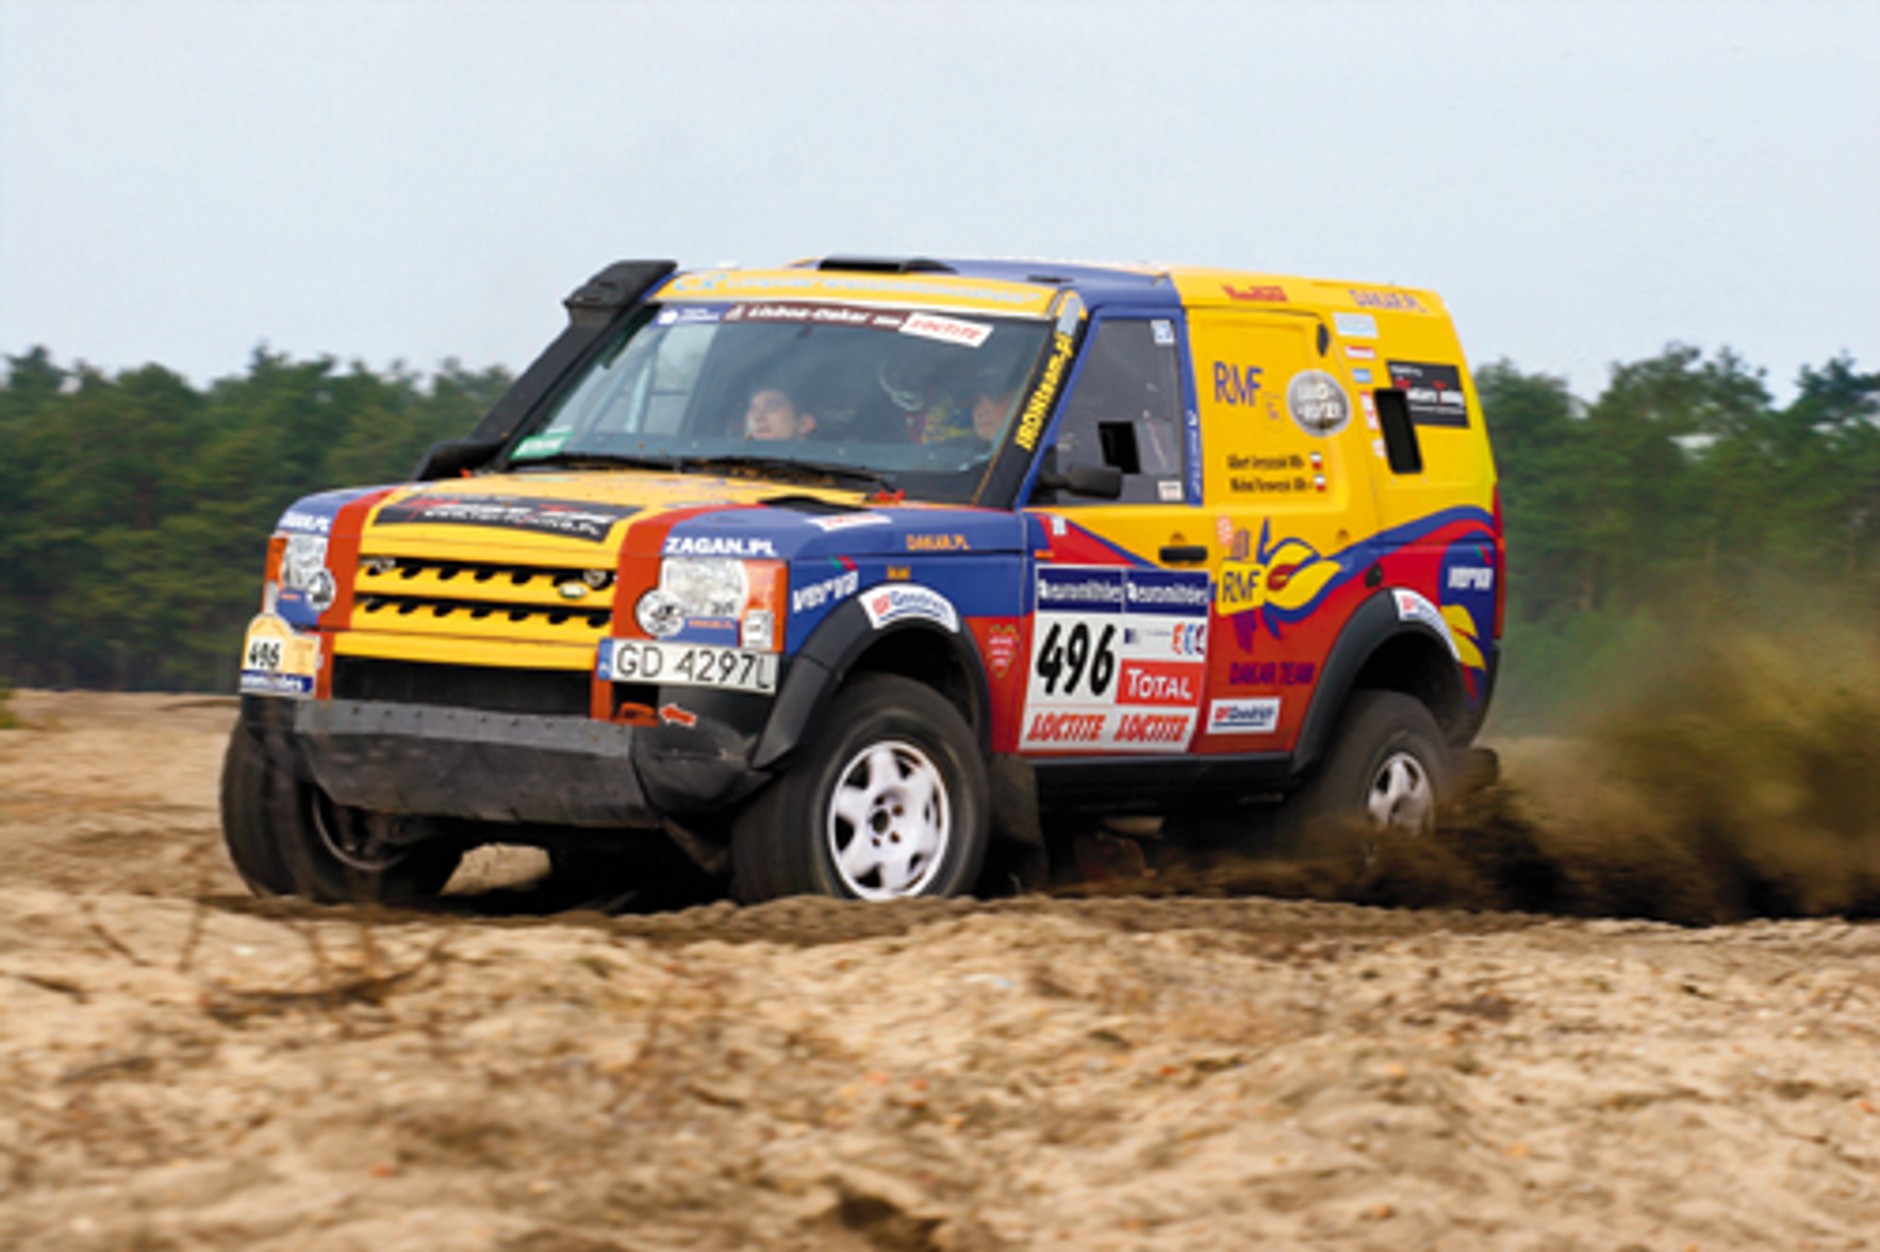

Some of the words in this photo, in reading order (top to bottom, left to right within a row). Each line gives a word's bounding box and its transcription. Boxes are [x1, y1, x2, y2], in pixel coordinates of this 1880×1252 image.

[1213, 361, 1263, 407] RMF
[664, 537, 777, 557] ZAGAN.PL
[616, 643, 664, 679] GD
[674, 650, 773, 690] 4297L
[1036, 621, 1117, 696] 496
[1127, 668, 1193, 700] TOTAL
[1027, 711, 1107, 743] LOCTITE
[1113, 712, 1190, 743] LOCTITE
